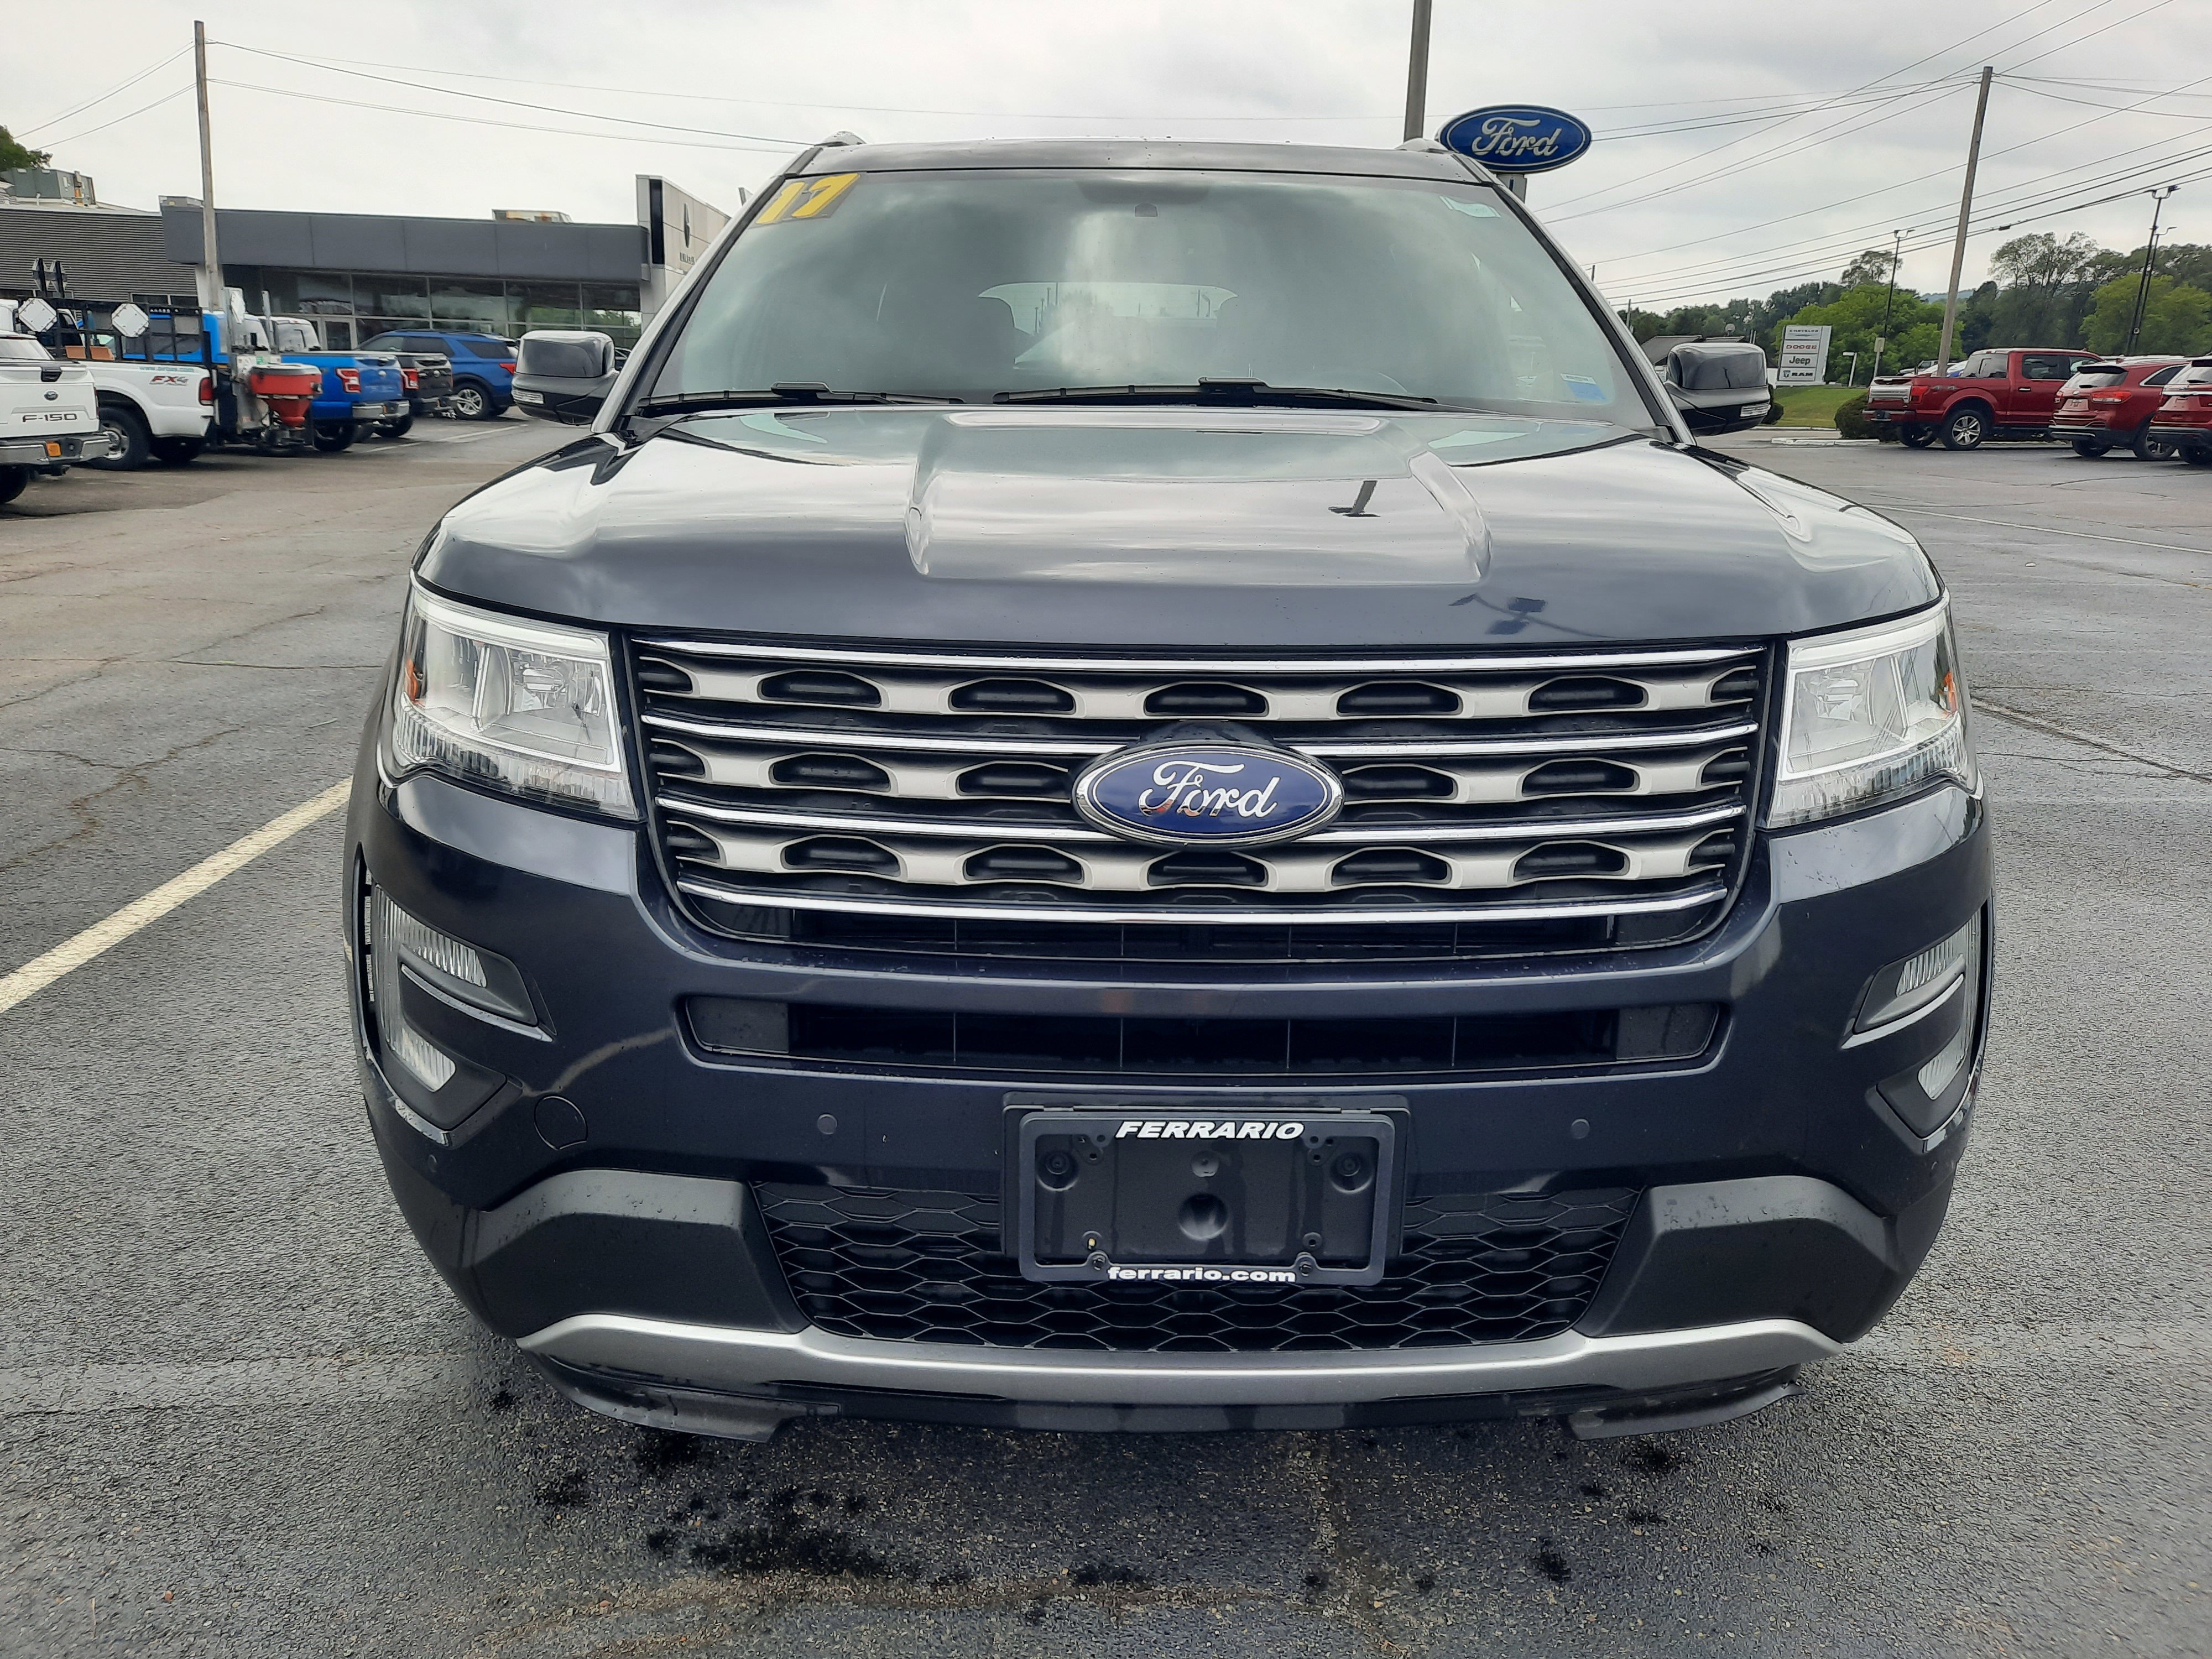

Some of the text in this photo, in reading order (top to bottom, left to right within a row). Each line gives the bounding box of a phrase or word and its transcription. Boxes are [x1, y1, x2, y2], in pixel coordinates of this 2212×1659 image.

[1472, 117, 1562, 156] Ford
[755, 173, 860, 225] 17
[1789, 356, 1811, 366] Jeep
[22, 413, 77, 422] F-150
[1138, 760, 1281, 818] Ford
[1115, 1121, 1306, 1140] FERRARIO
[1107, 1266, 1296, 1282] ferrario.com
